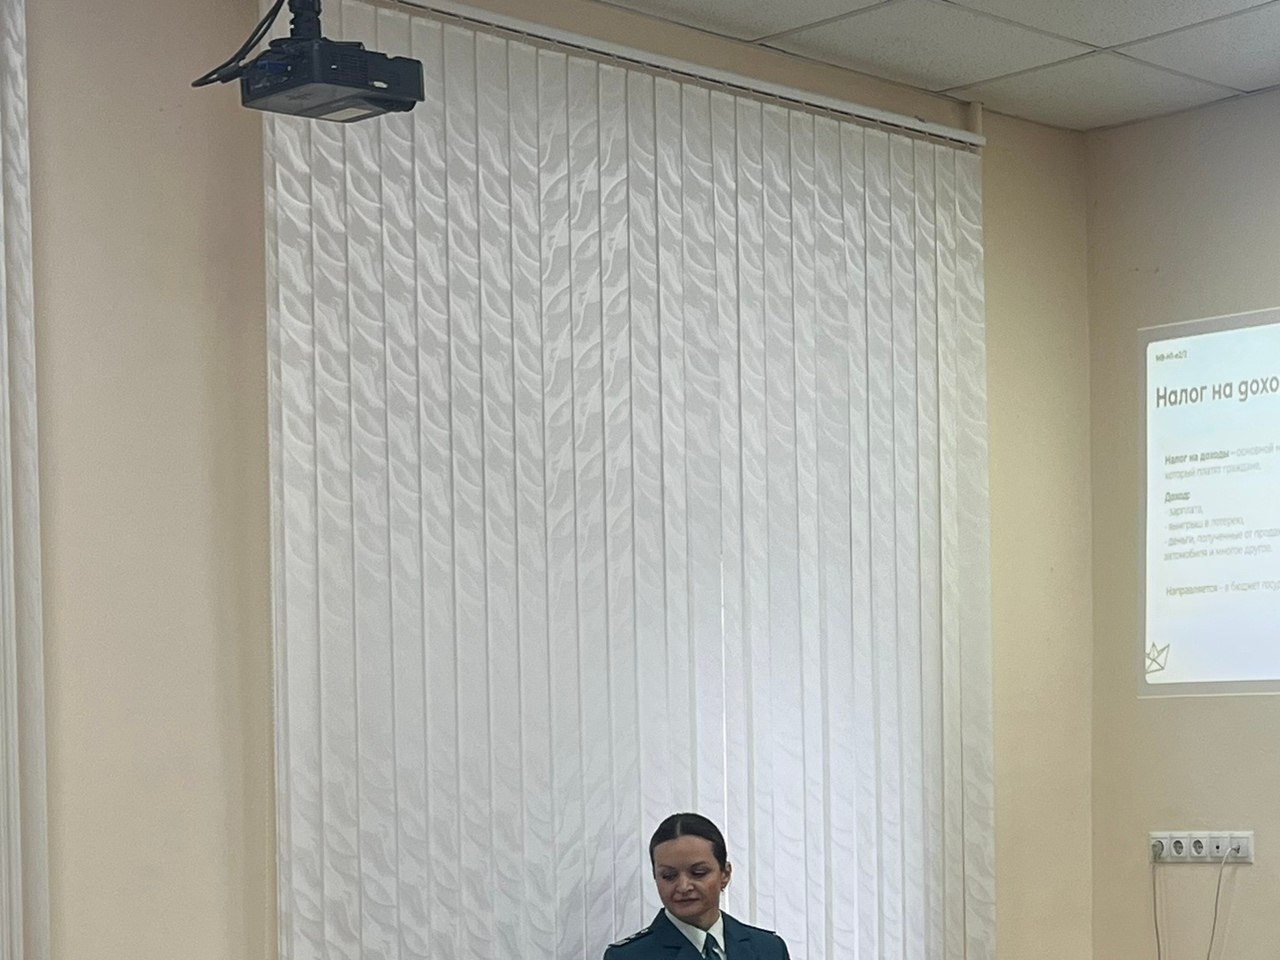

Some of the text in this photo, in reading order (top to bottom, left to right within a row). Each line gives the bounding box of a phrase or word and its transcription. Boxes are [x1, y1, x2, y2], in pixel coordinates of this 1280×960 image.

[1156, 385, 1207, 408] Налог
[1212, 382, 1233, 401] на
[1165, 454, 1187, 465] Налог
[1189, 453, 1198, 462] на
[1200, 450, 1230, 461] доходы
